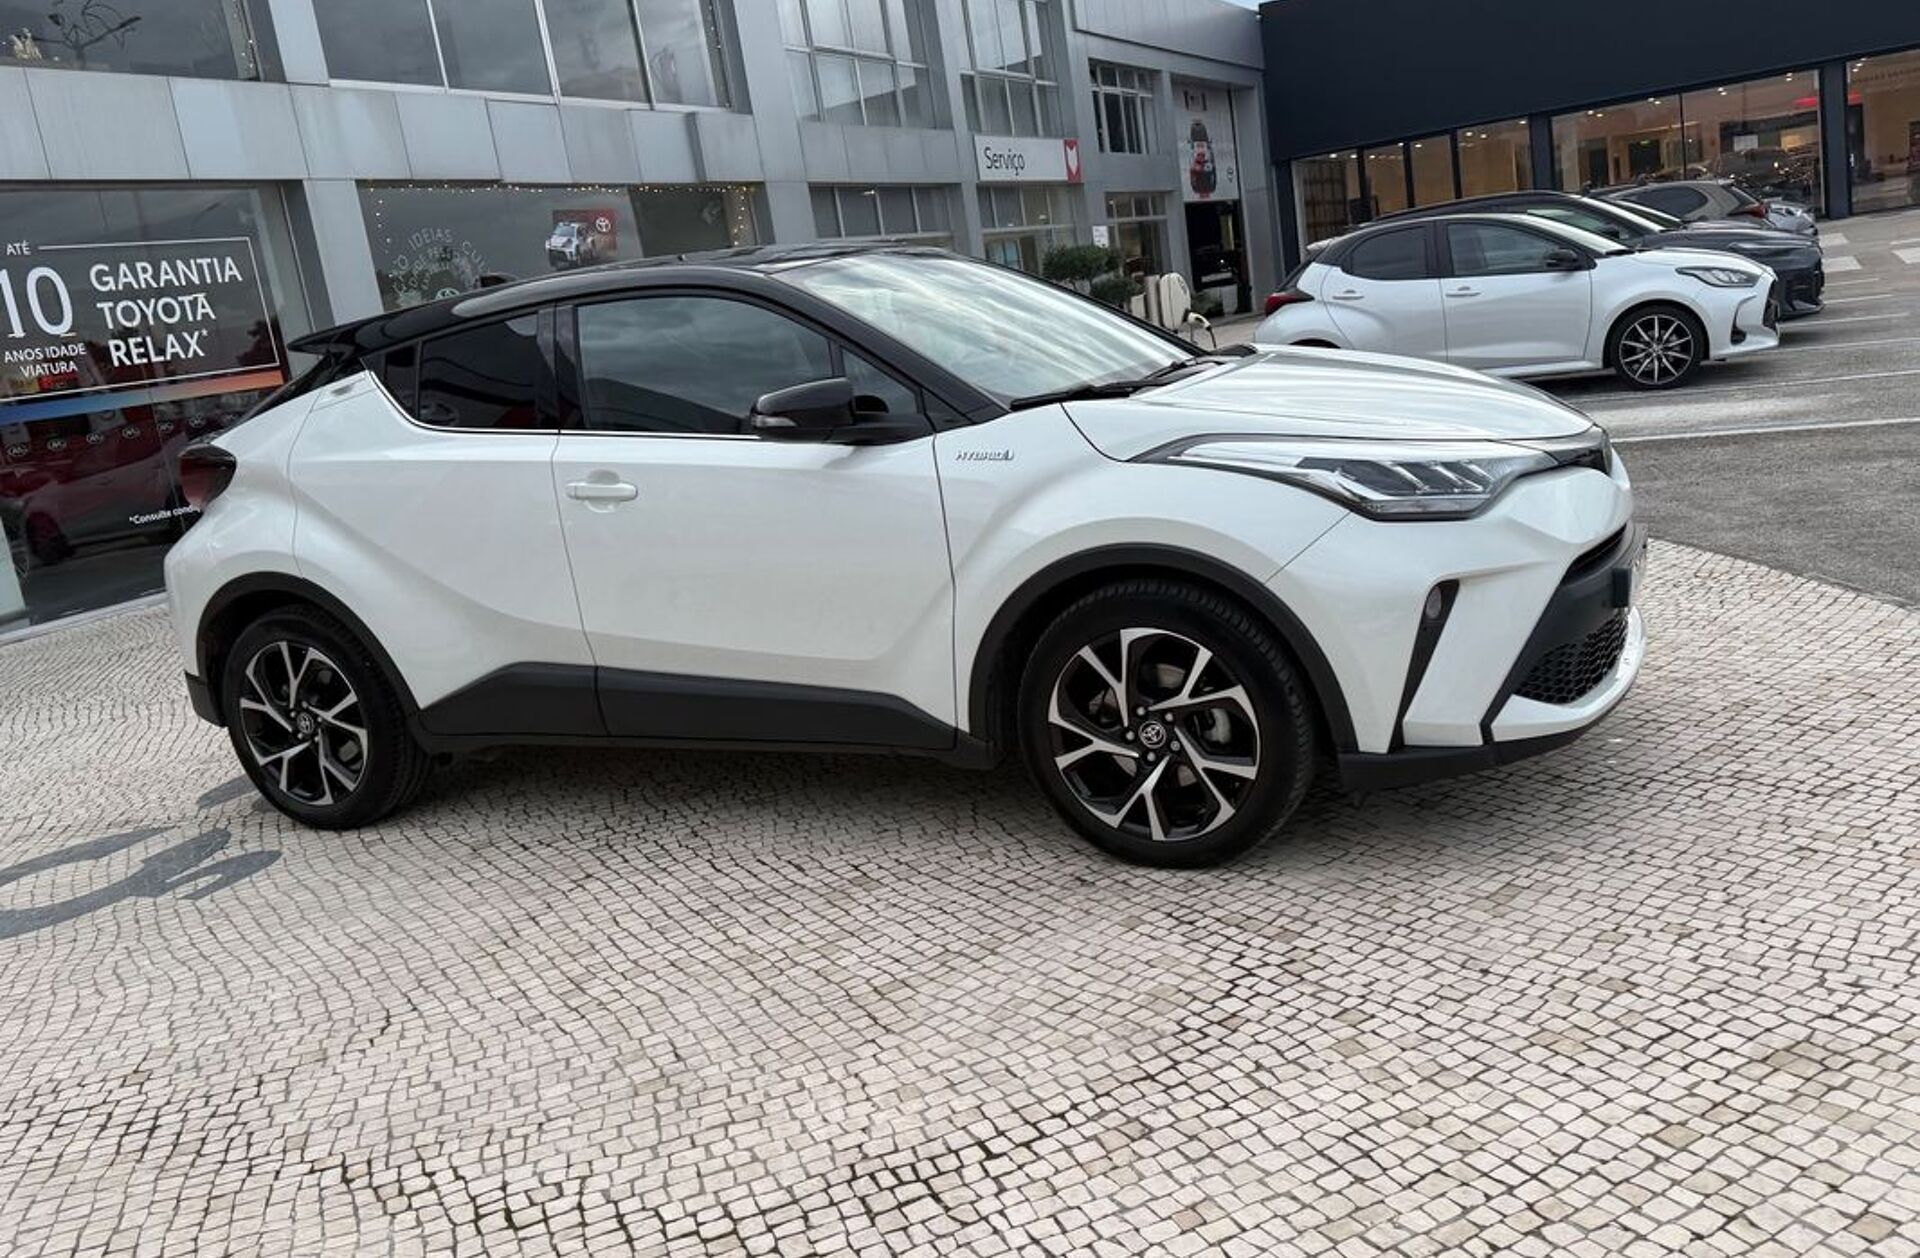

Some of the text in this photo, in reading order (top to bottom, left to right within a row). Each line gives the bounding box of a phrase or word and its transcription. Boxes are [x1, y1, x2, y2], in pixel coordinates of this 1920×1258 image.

[984, 146, 1025, 176] Serviço
[6, 240, 31, 256] ATÉ
[89, 256, 243, 292] GARANTIA
[0, 266, 73, 338] 10
[96, 293, 216, 330] TOYOTA
[4, 343, 87, 364] ANOS IDADE
[20, 360, 79, 378] VIATURA
